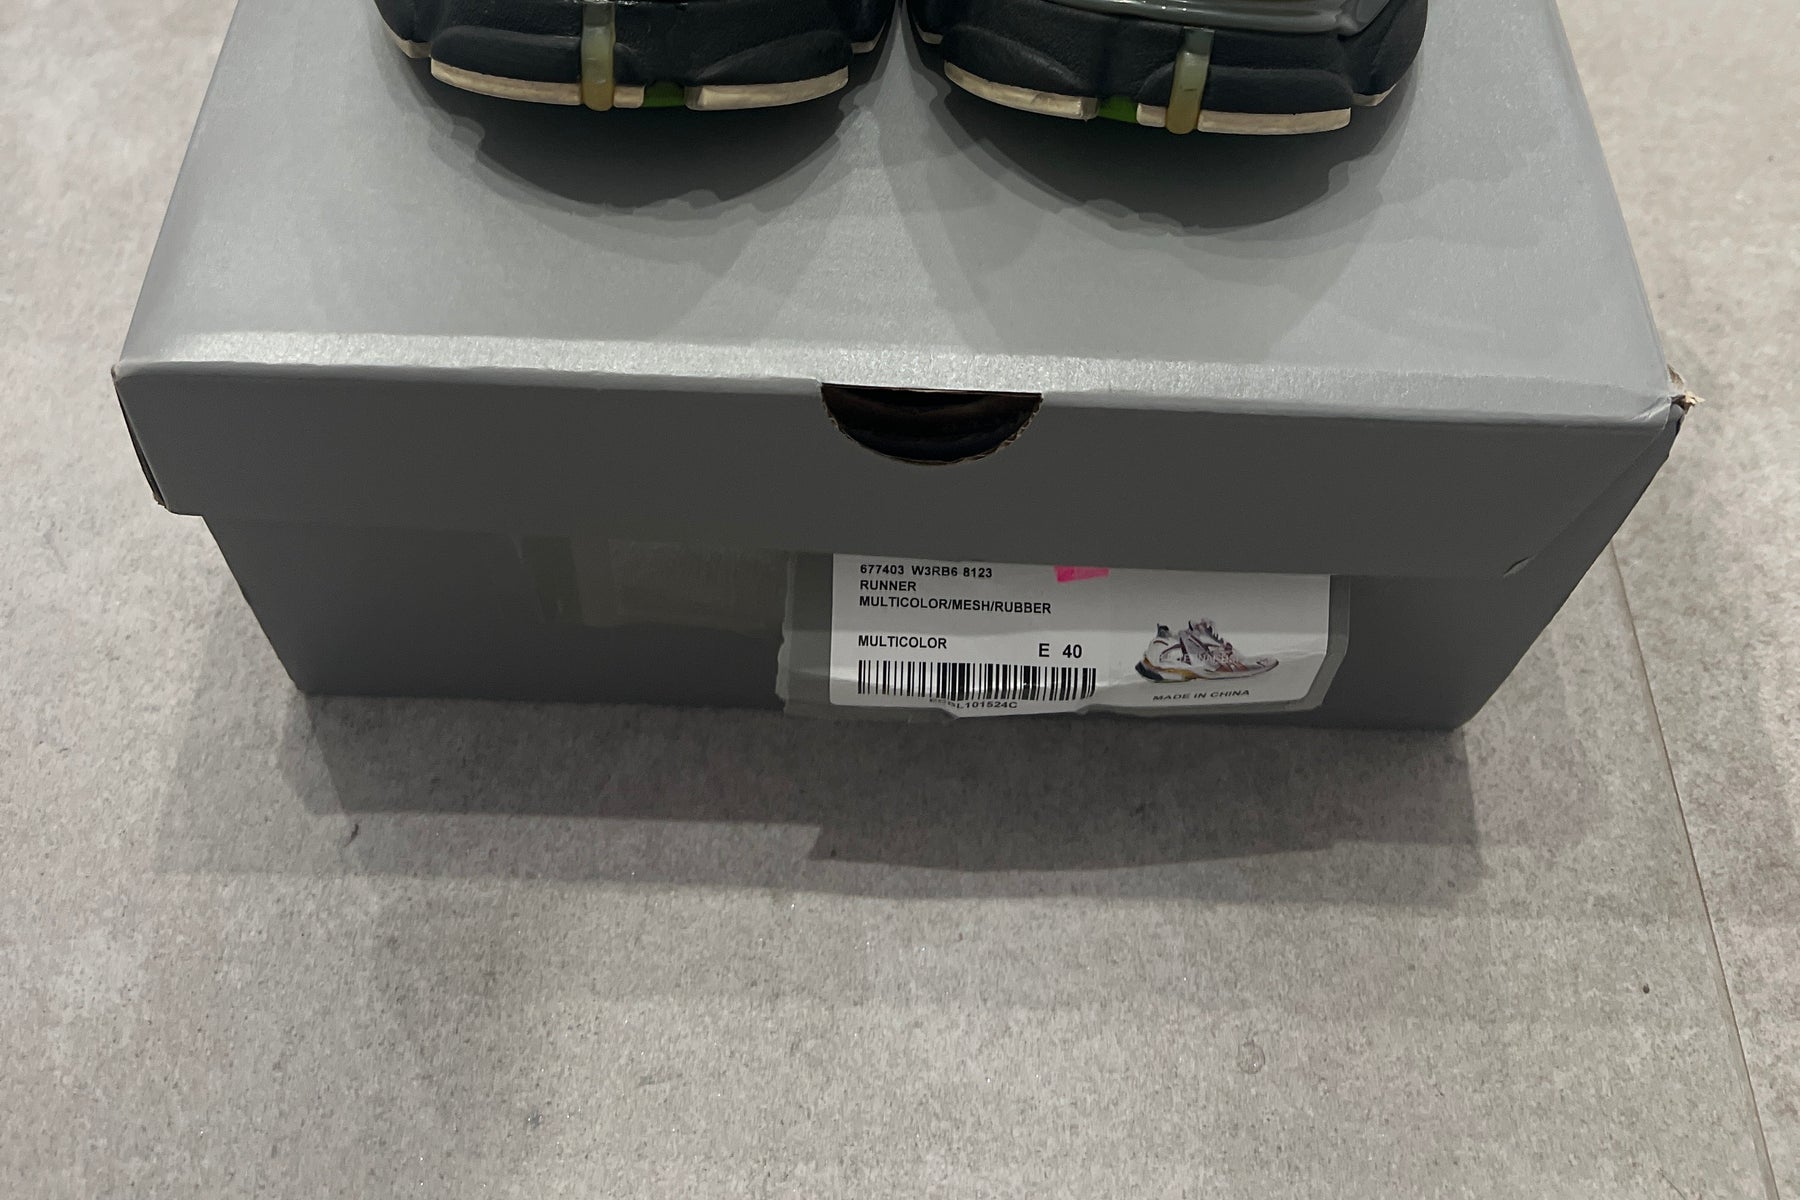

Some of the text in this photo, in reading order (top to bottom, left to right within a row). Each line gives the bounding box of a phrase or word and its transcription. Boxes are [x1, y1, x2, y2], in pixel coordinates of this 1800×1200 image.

[860, 564, 993, 578] 677403 W3RB6 8123
[860, 580, 917, 591] RUNNER
[859, 596, 1052, 614] MULTICOLOR/MESH/RUBBER
[858, 635, 948, 649] MULTICOLOR
[1038, 643, 1083, 658] E 40
[1152, 693, 1190, 701] MADE
[1210, 689, 1250, 698] CHINA
